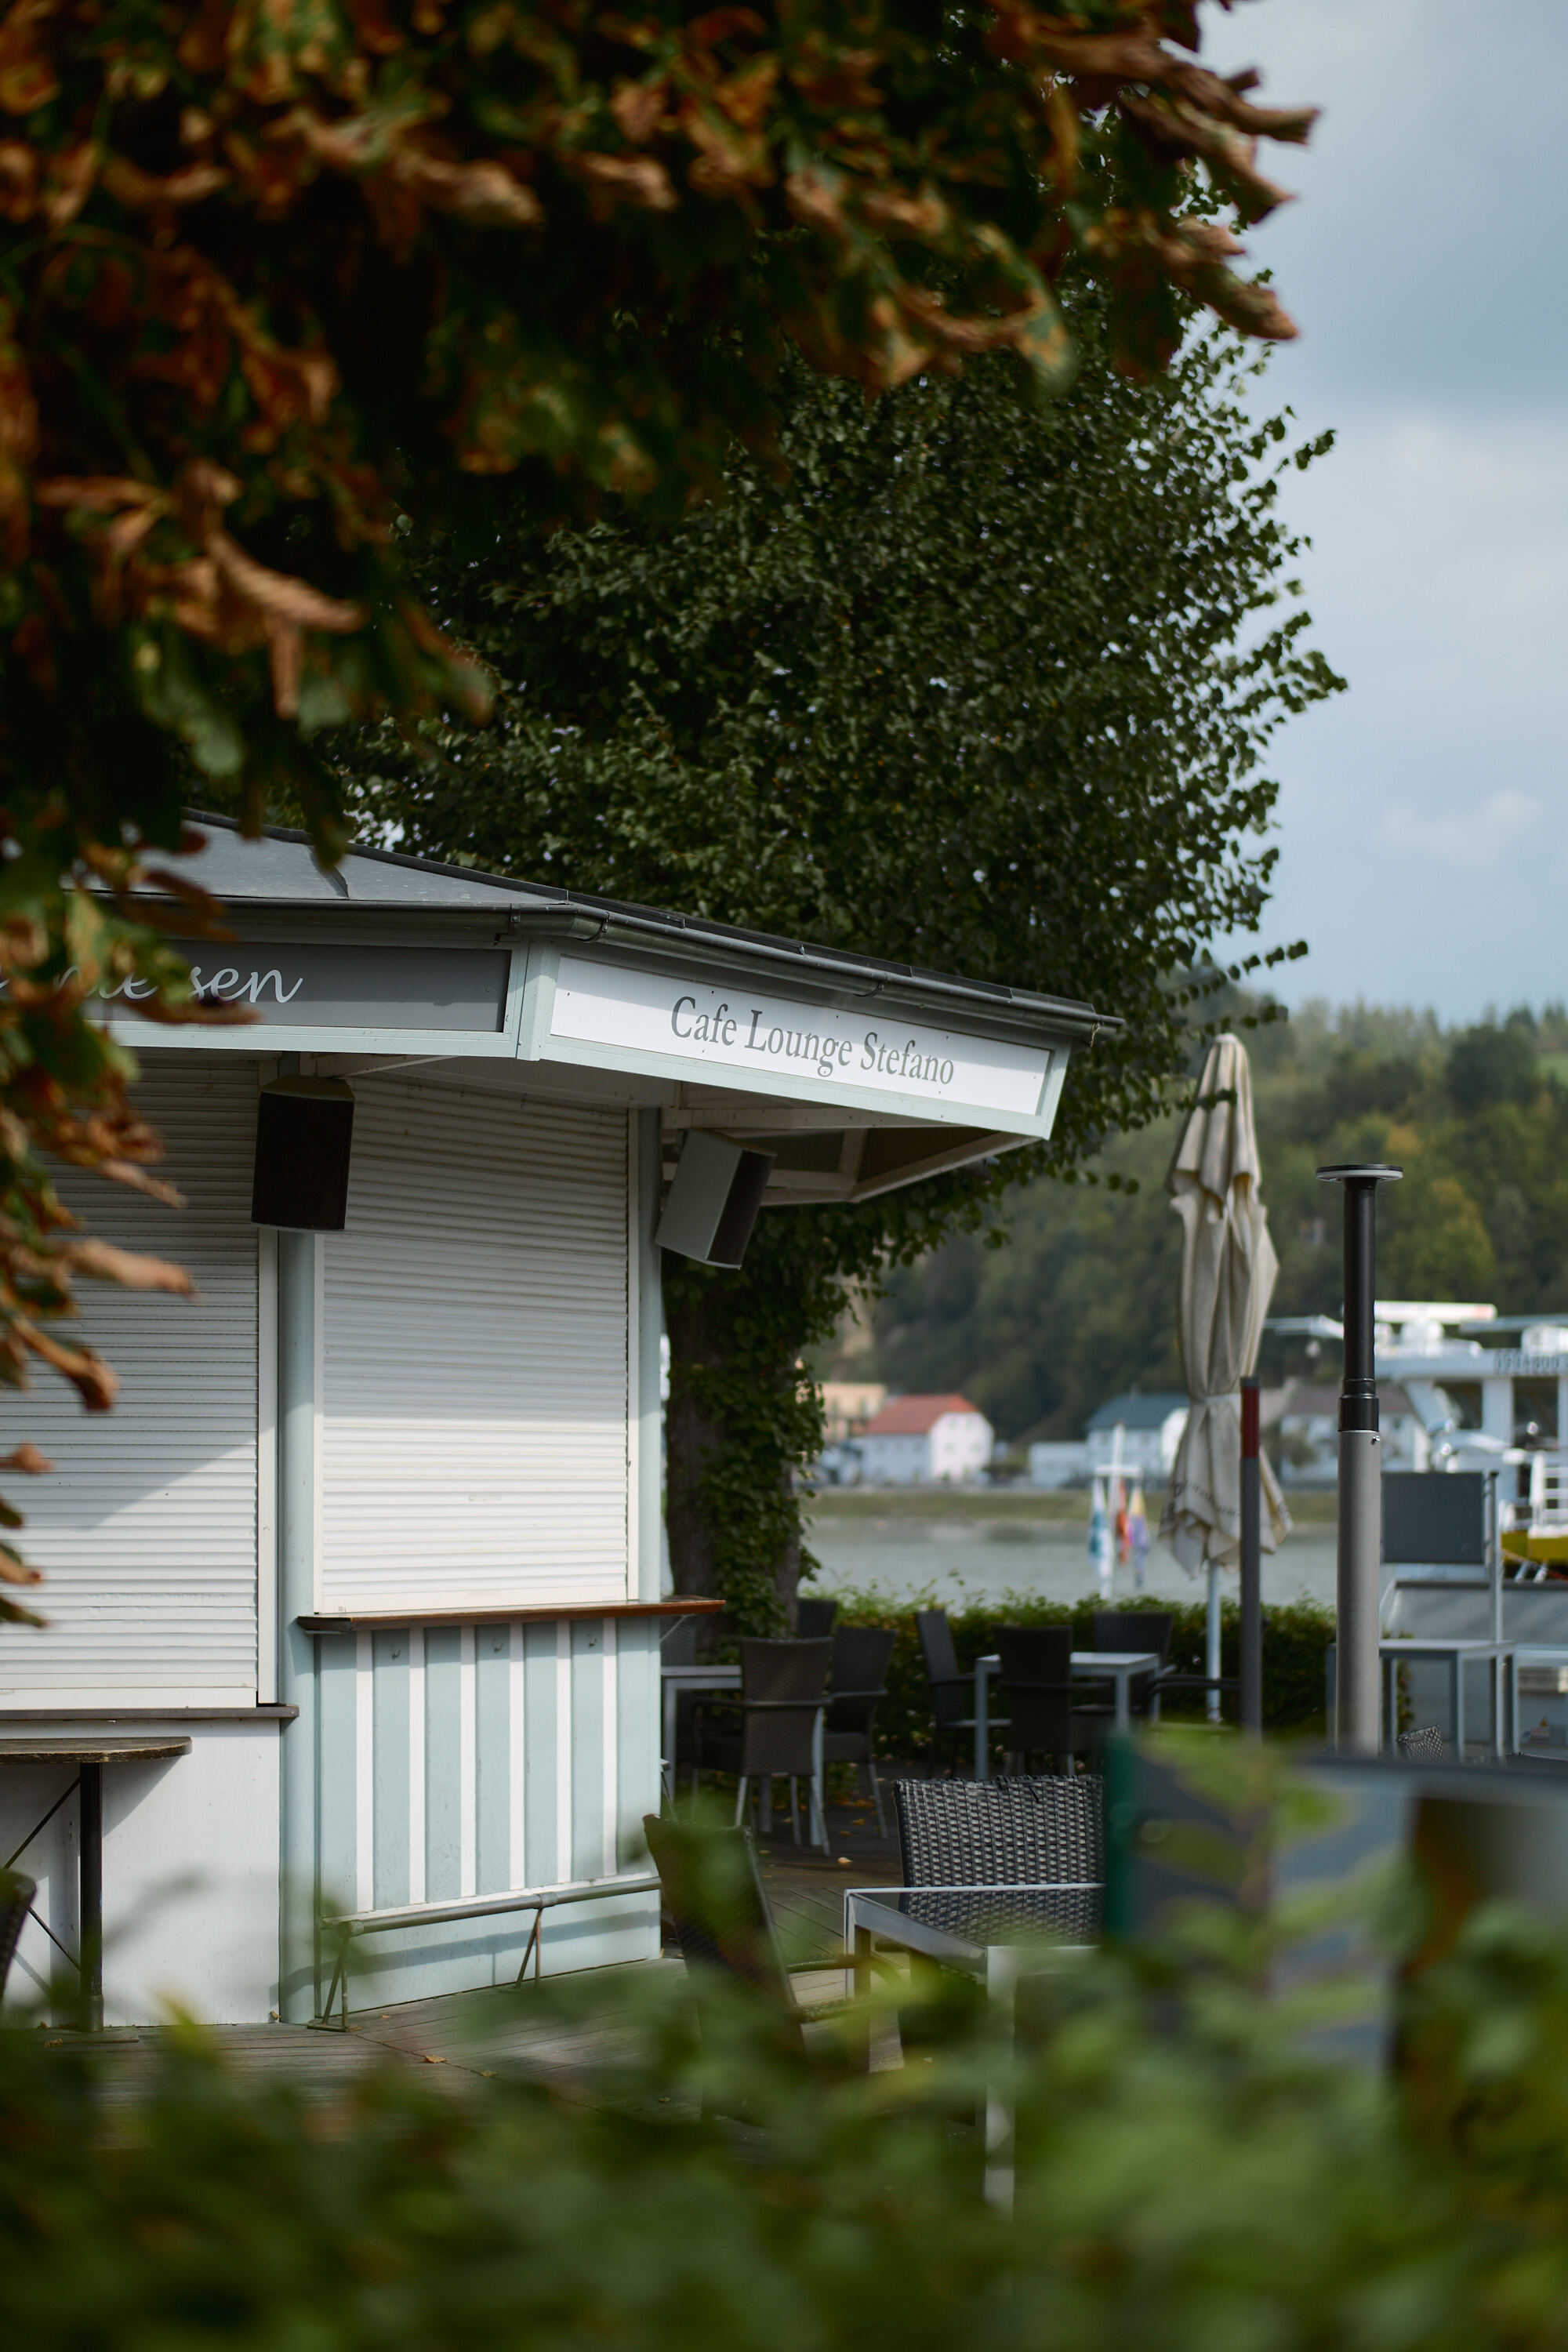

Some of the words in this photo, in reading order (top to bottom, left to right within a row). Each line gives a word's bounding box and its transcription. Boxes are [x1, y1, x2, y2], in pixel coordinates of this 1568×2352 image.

[671, 996, 737, 1047] Cafe
[744, 1009, 852, 1077] Lounge
[860, 1032, 954, 1084] Stefano
